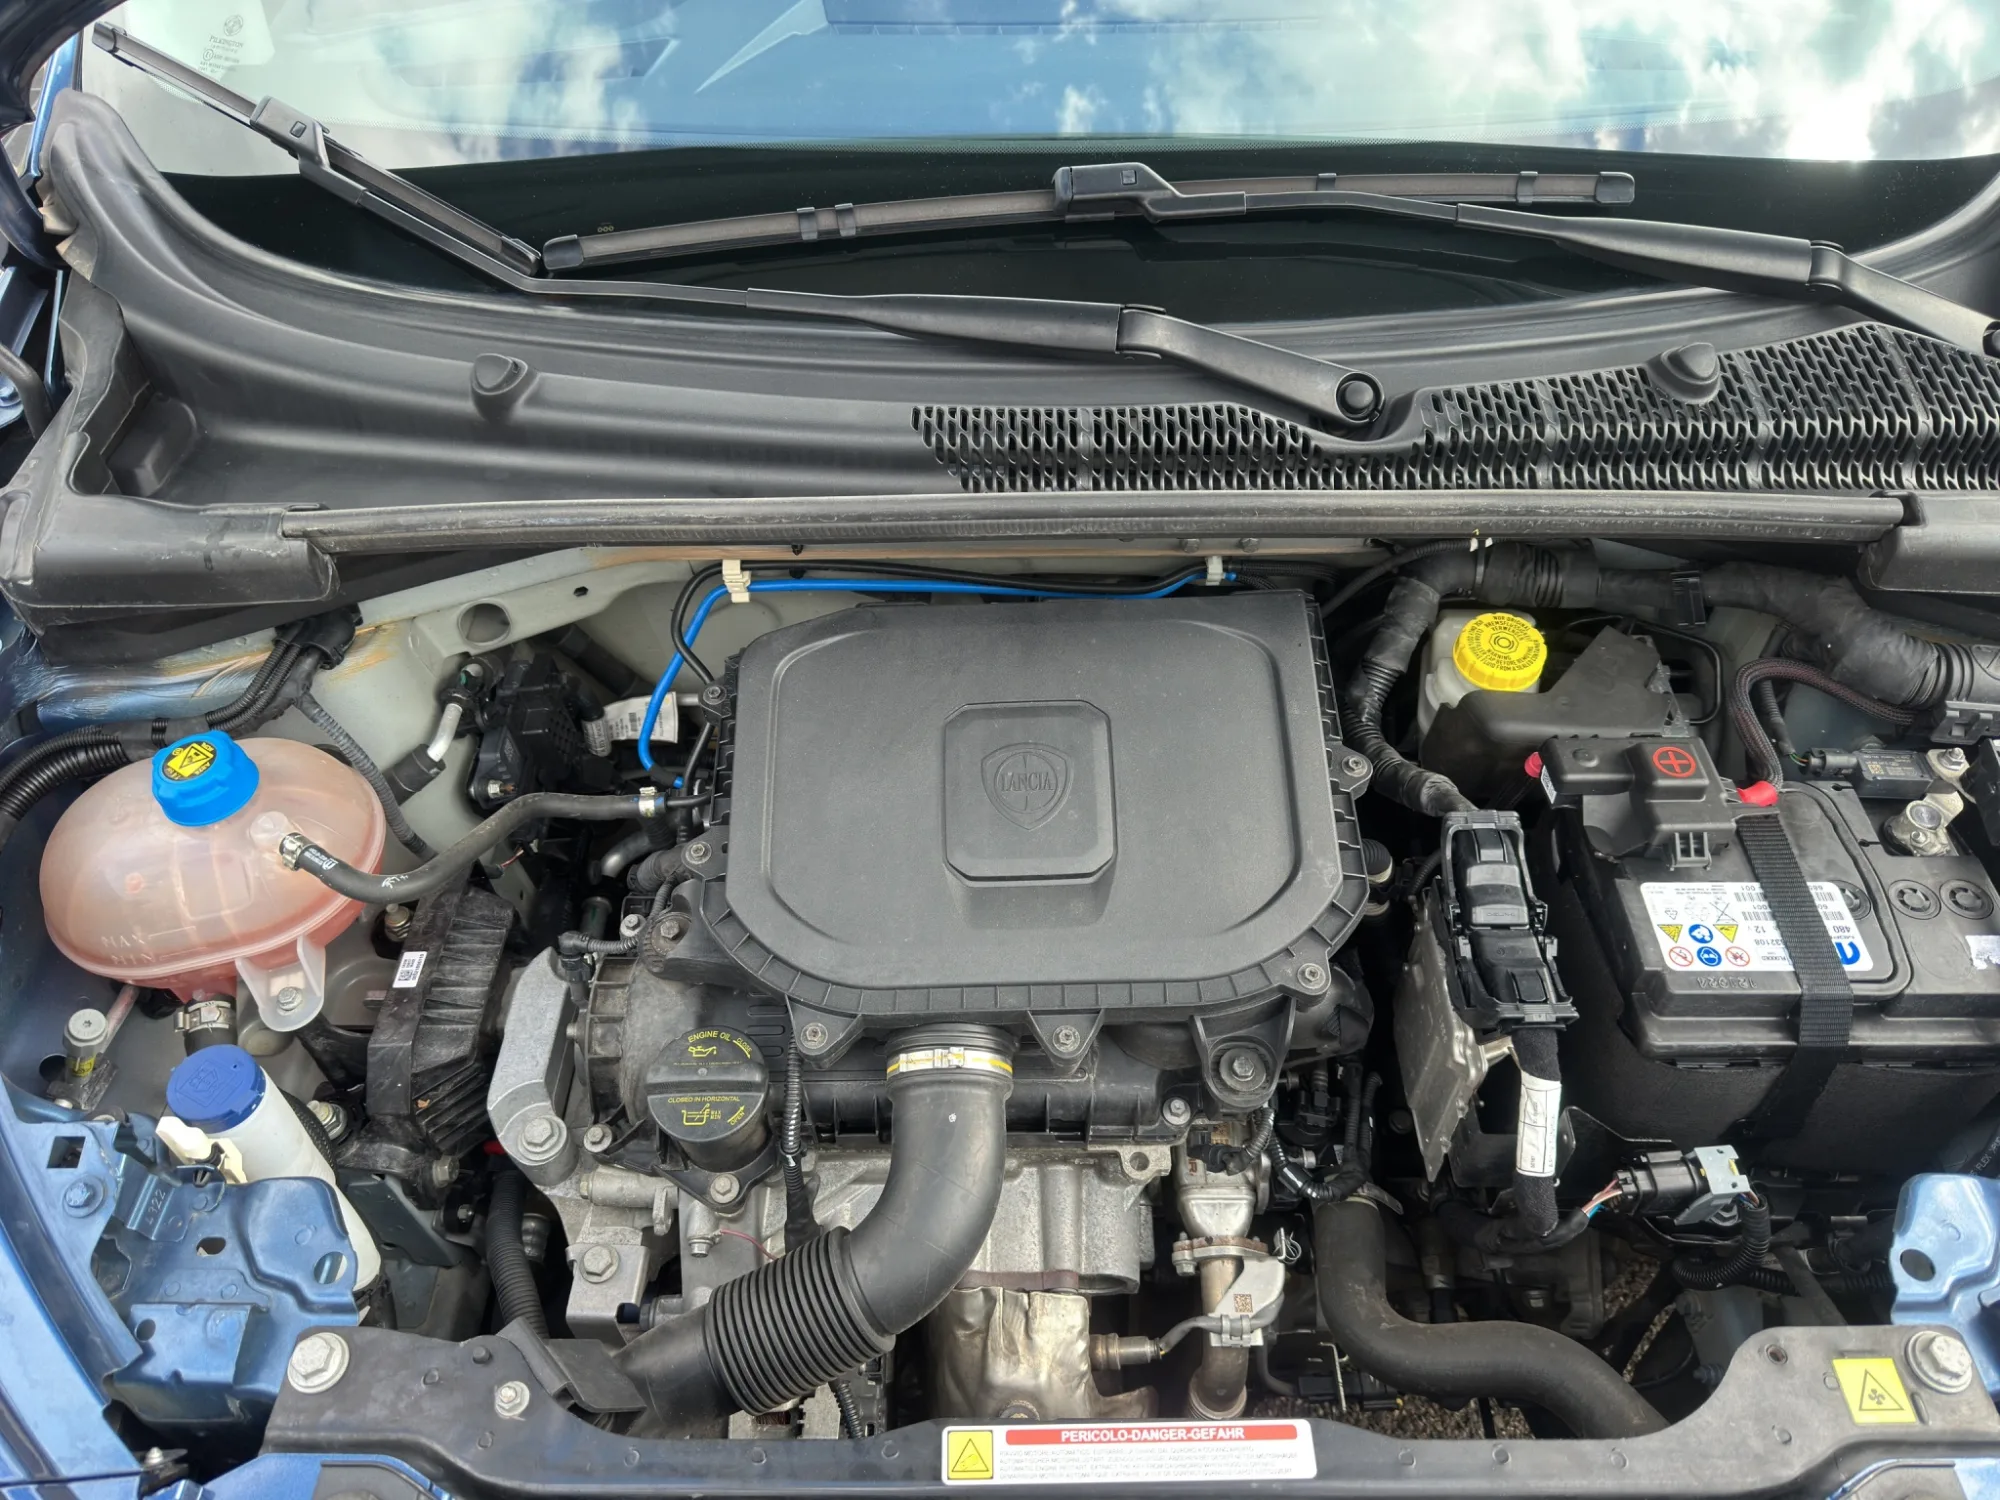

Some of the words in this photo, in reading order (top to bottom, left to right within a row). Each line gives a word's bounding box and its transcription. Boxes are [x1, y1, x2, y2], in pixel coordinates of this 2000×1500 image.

[1486, 648, 1512, 660] WARNING
[1000, 771, 1054, 792] LANCIA
[1754, 925, 1767, 934] 12
[1832, 925, 1851, 934] 480
[687, 1030, 719, 1043] ENGINE
[719, 1031, 731, 1042] OIL
[736, 1037, 753, 1052] CLOSE
[667, 1096, 693, 1104] CLOSED
[701, 1095, 741, 1103] HORIZONTAL
[730, 1111, 746, 1126] OPEN
[1060, 1427, 1246, 1443] PERICOLO-DANGER-GEFAHR
